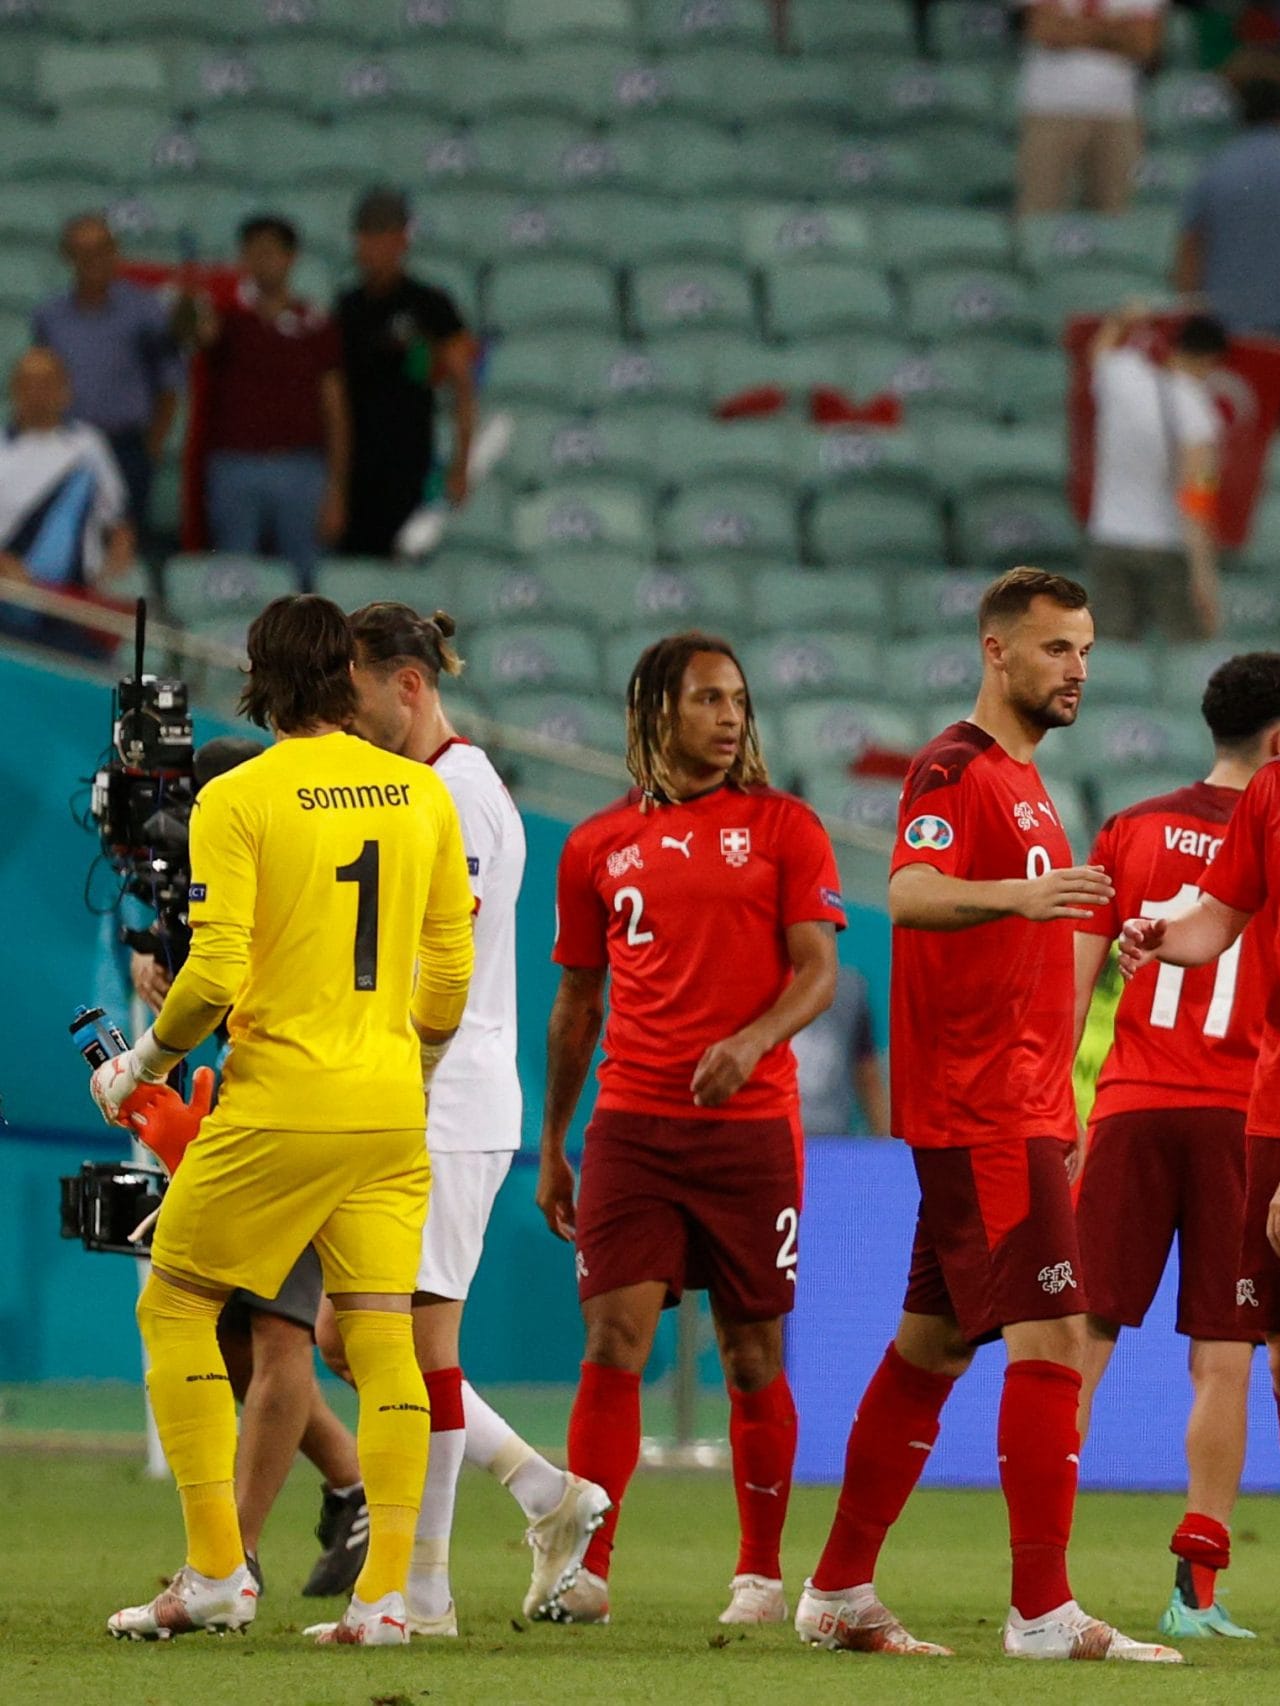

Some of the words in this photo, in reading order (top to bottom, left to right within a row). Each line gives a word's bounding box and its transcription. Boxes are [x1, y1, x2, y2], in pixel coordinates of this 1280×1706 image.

[297, 784, 410, 811] sommer
[336, 840, 379, 991] 1
[614, 886, 654, 946] 2
[1139, 882, 1244, 1039] 11
[775, 1206, 797, 1268] 2
